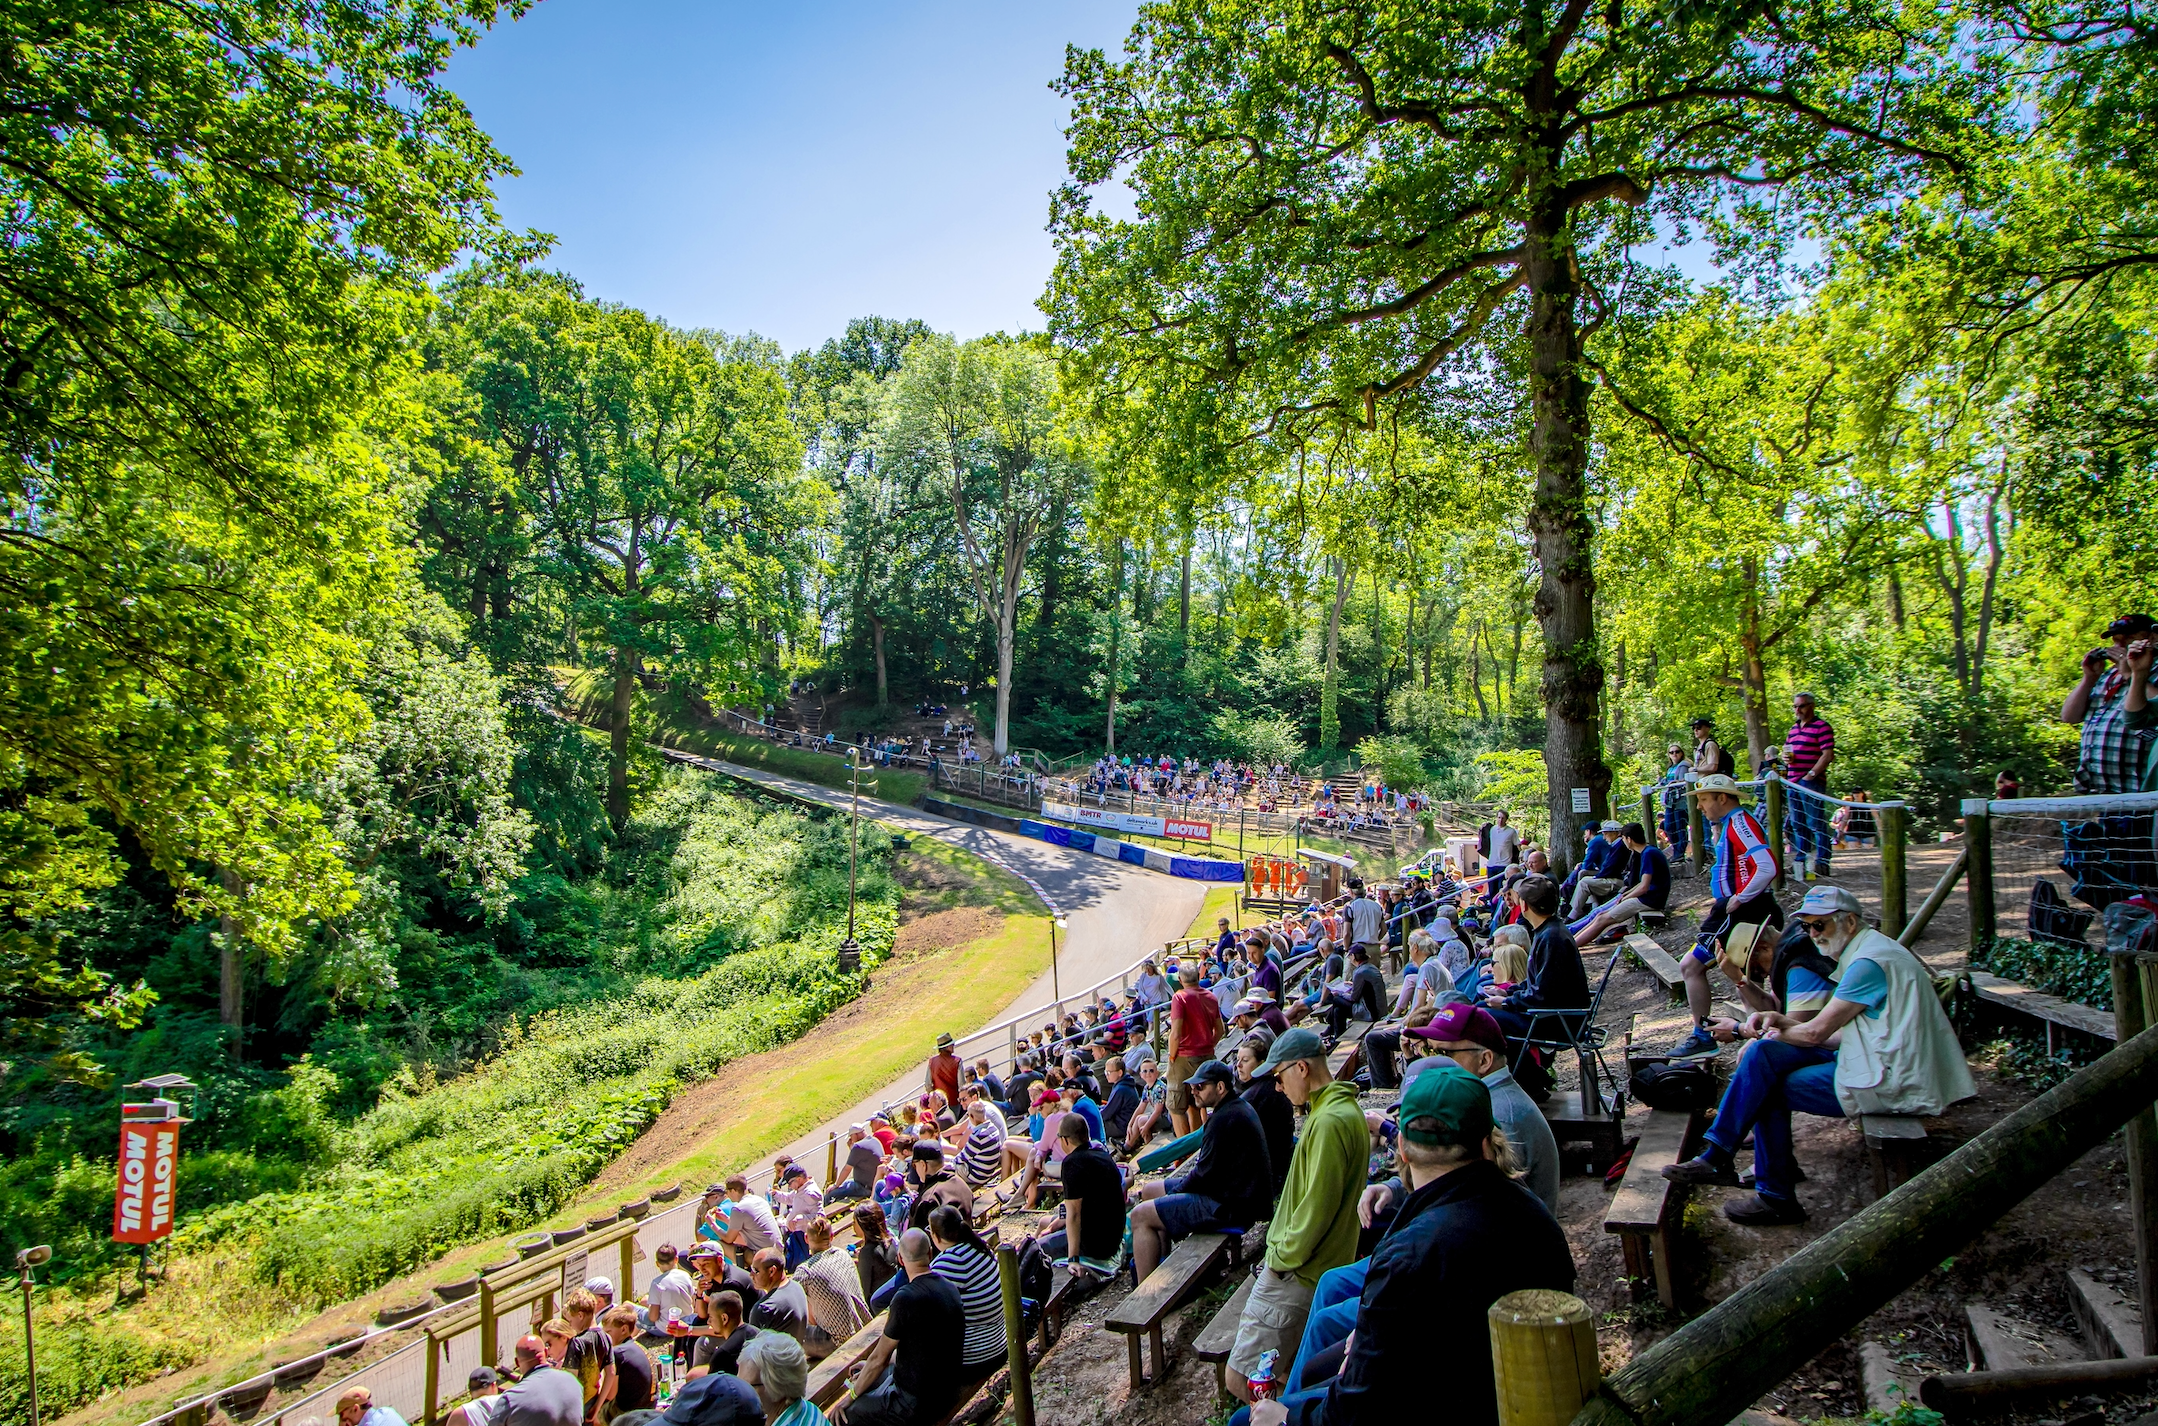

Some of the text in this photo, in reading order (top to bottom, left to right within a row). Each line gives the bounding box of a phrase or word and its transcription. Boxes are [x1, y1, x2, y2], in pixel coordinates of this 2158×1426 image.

[1166, 822, 1209, 838] MOTUL
[120, 1131, 147, 1233] MOTUL
[151, 1132, 174, 1231] MOTUL
